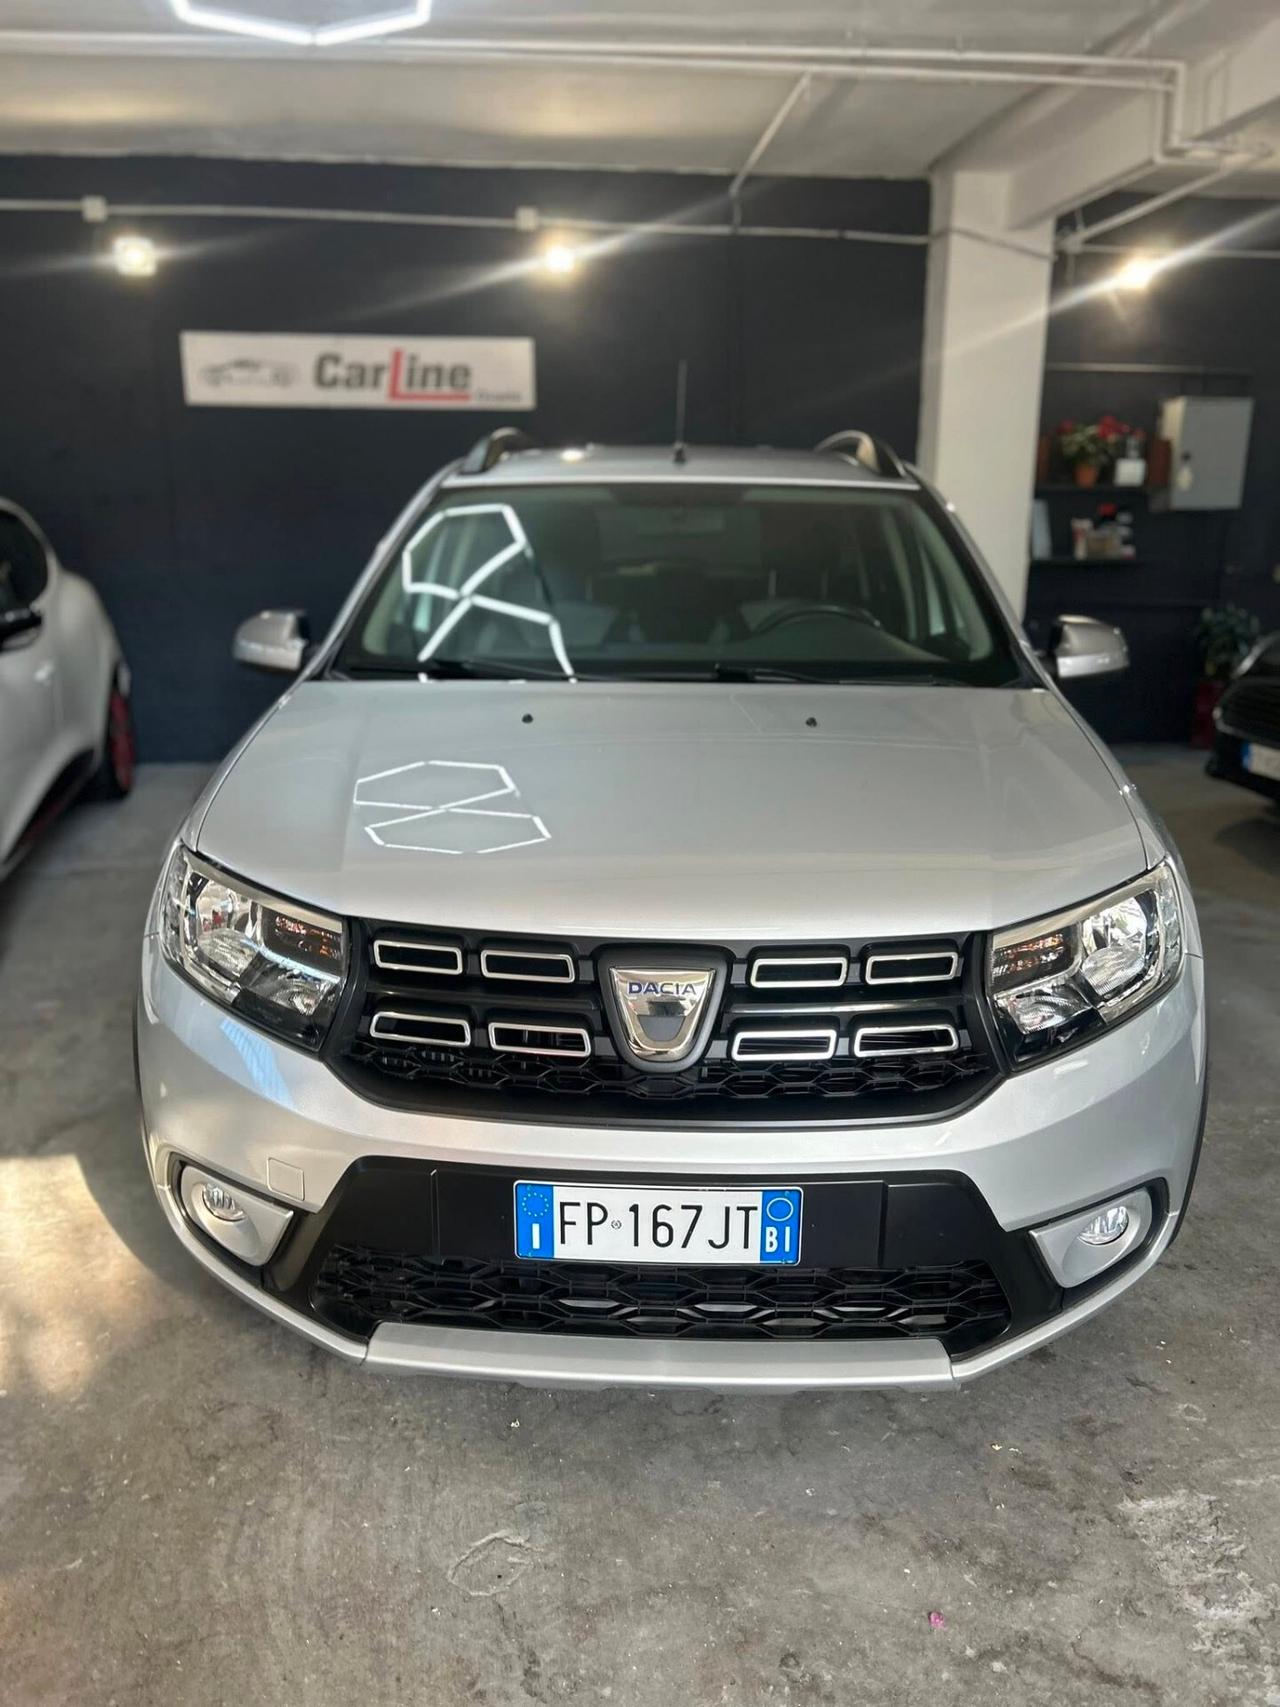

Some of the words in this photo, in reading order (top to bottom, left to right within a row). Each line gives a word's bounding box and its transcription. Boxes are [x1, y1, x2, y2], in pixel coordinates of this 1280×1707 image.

[314, 349, 472, 401] CarLine
[628, 981, 697, 995] DACIA
[531, 1223, 540, 1249] I
[765, 1226, 791, 1253] BI
